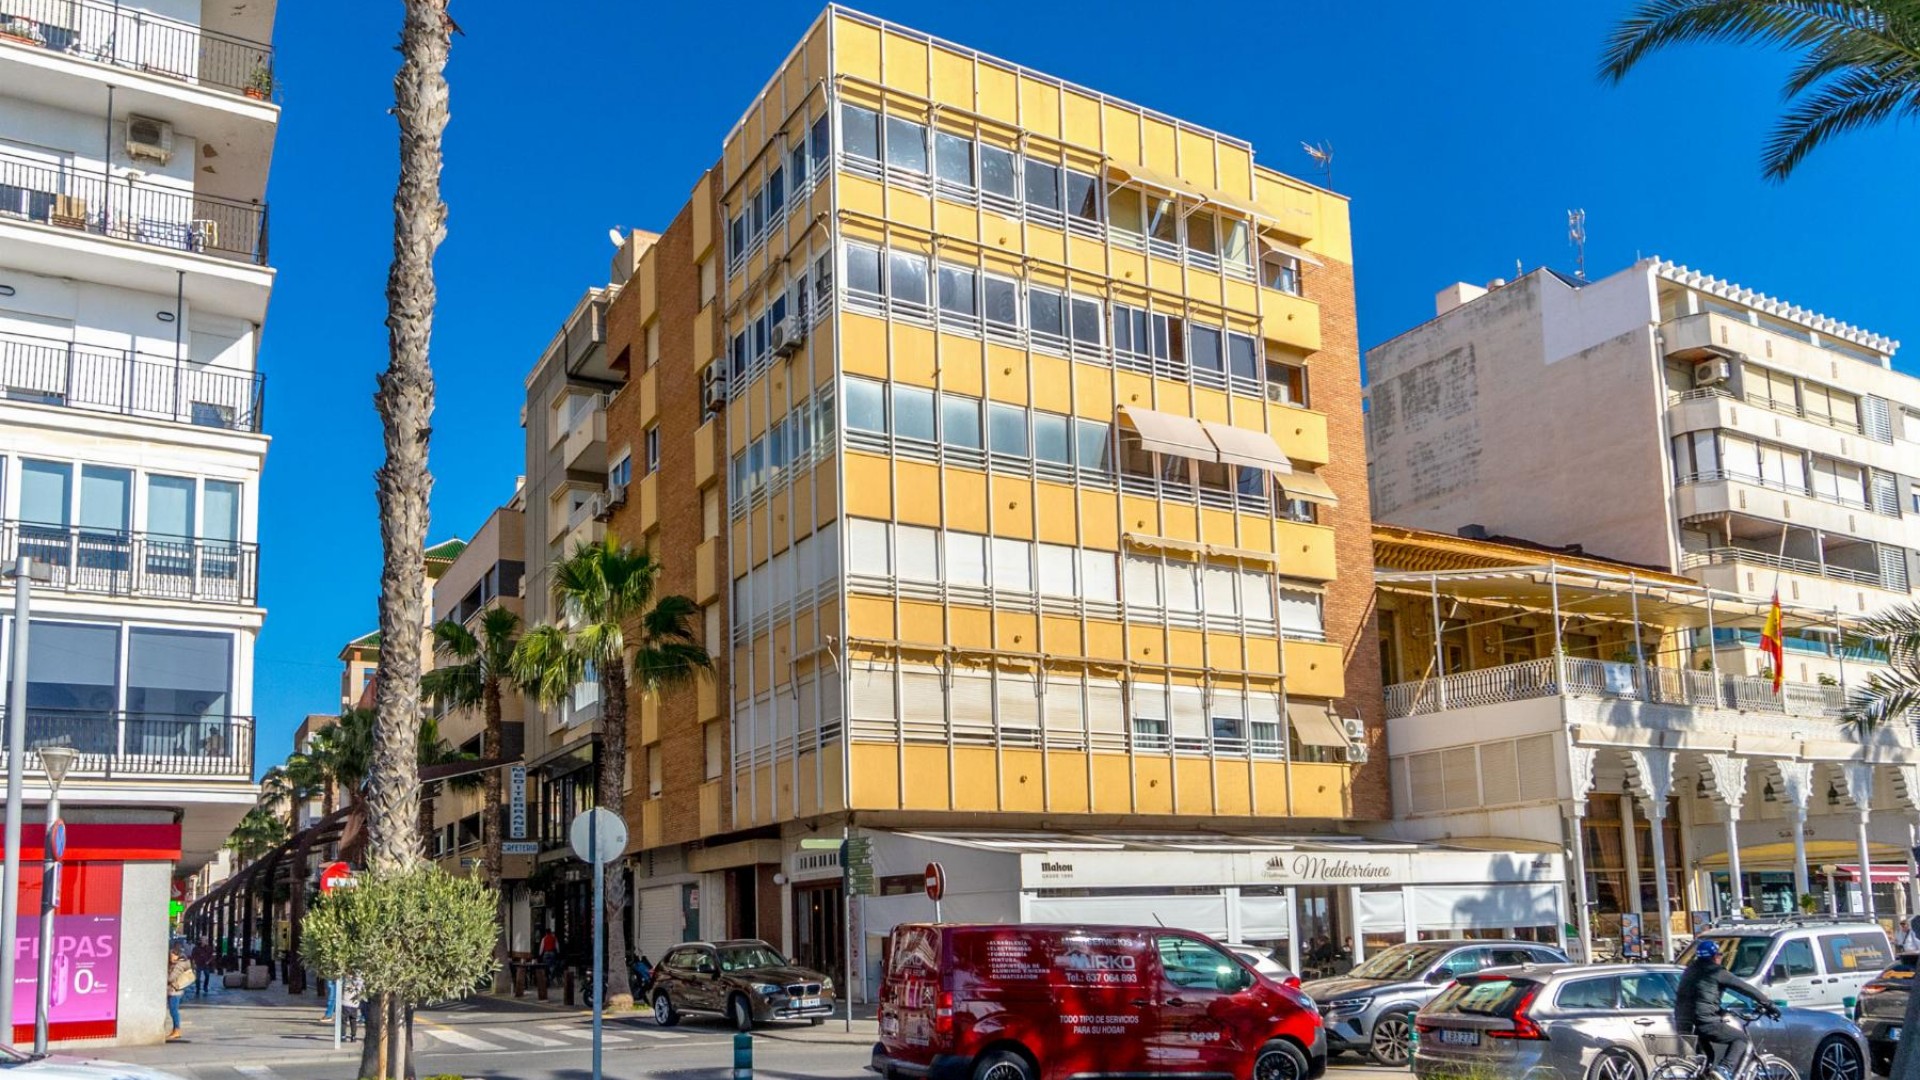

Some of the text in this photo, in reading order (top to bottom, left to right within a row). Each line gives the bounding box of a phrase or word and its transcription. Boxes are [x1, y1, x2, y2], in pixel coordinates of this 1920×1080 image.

[1041, 862, 1073, 872] Mahou
[1293, 855, 1391, 880] Mediterráneo
[14, 934, 113, 959] FPAS
[1060, 1015, 1139, 1023] TODO TIPO DE SERVICIOS
[1073, 1026, 1126, 1034] PARA SU HOGAR
